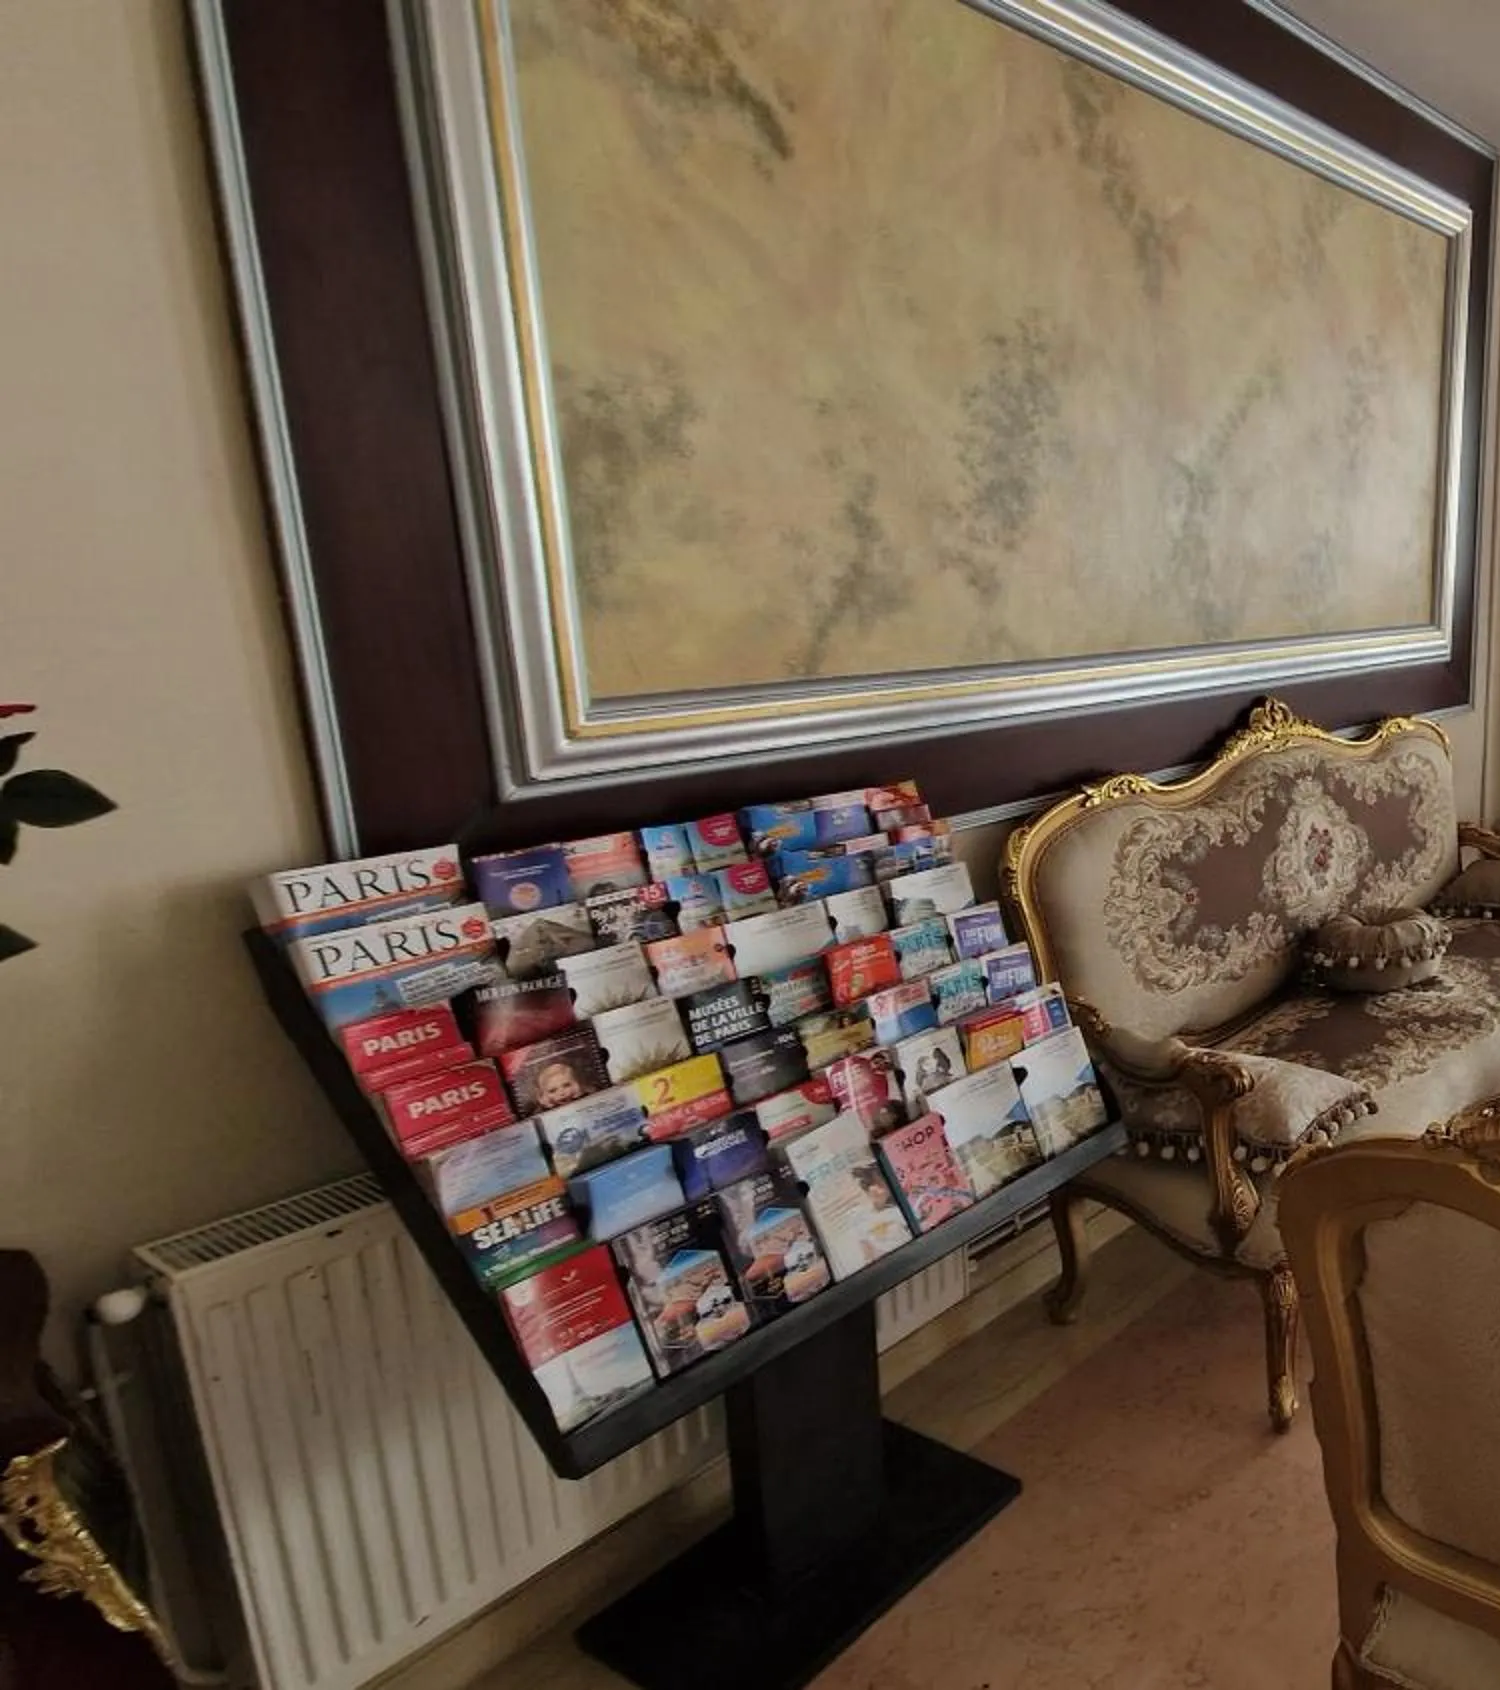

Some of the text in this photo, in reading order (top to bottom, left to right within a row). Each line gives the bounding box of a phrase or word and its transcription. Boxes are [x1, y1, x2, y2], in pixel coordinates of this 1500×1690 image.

[282, 858, 432, 913] PARIS
[313, 919, 459, 978] PARIS
[520, 974, 565, 993] ROUGE
[691, 1001, 764, 1034] DE LA VILLE
[695, 1019, 752, 1046] DE PARIS
[362, 1021, 442, 1057] PARIS
[407, 1080, 488, 1119] PARIS
[472, 1215, 518, 1250] SEA
